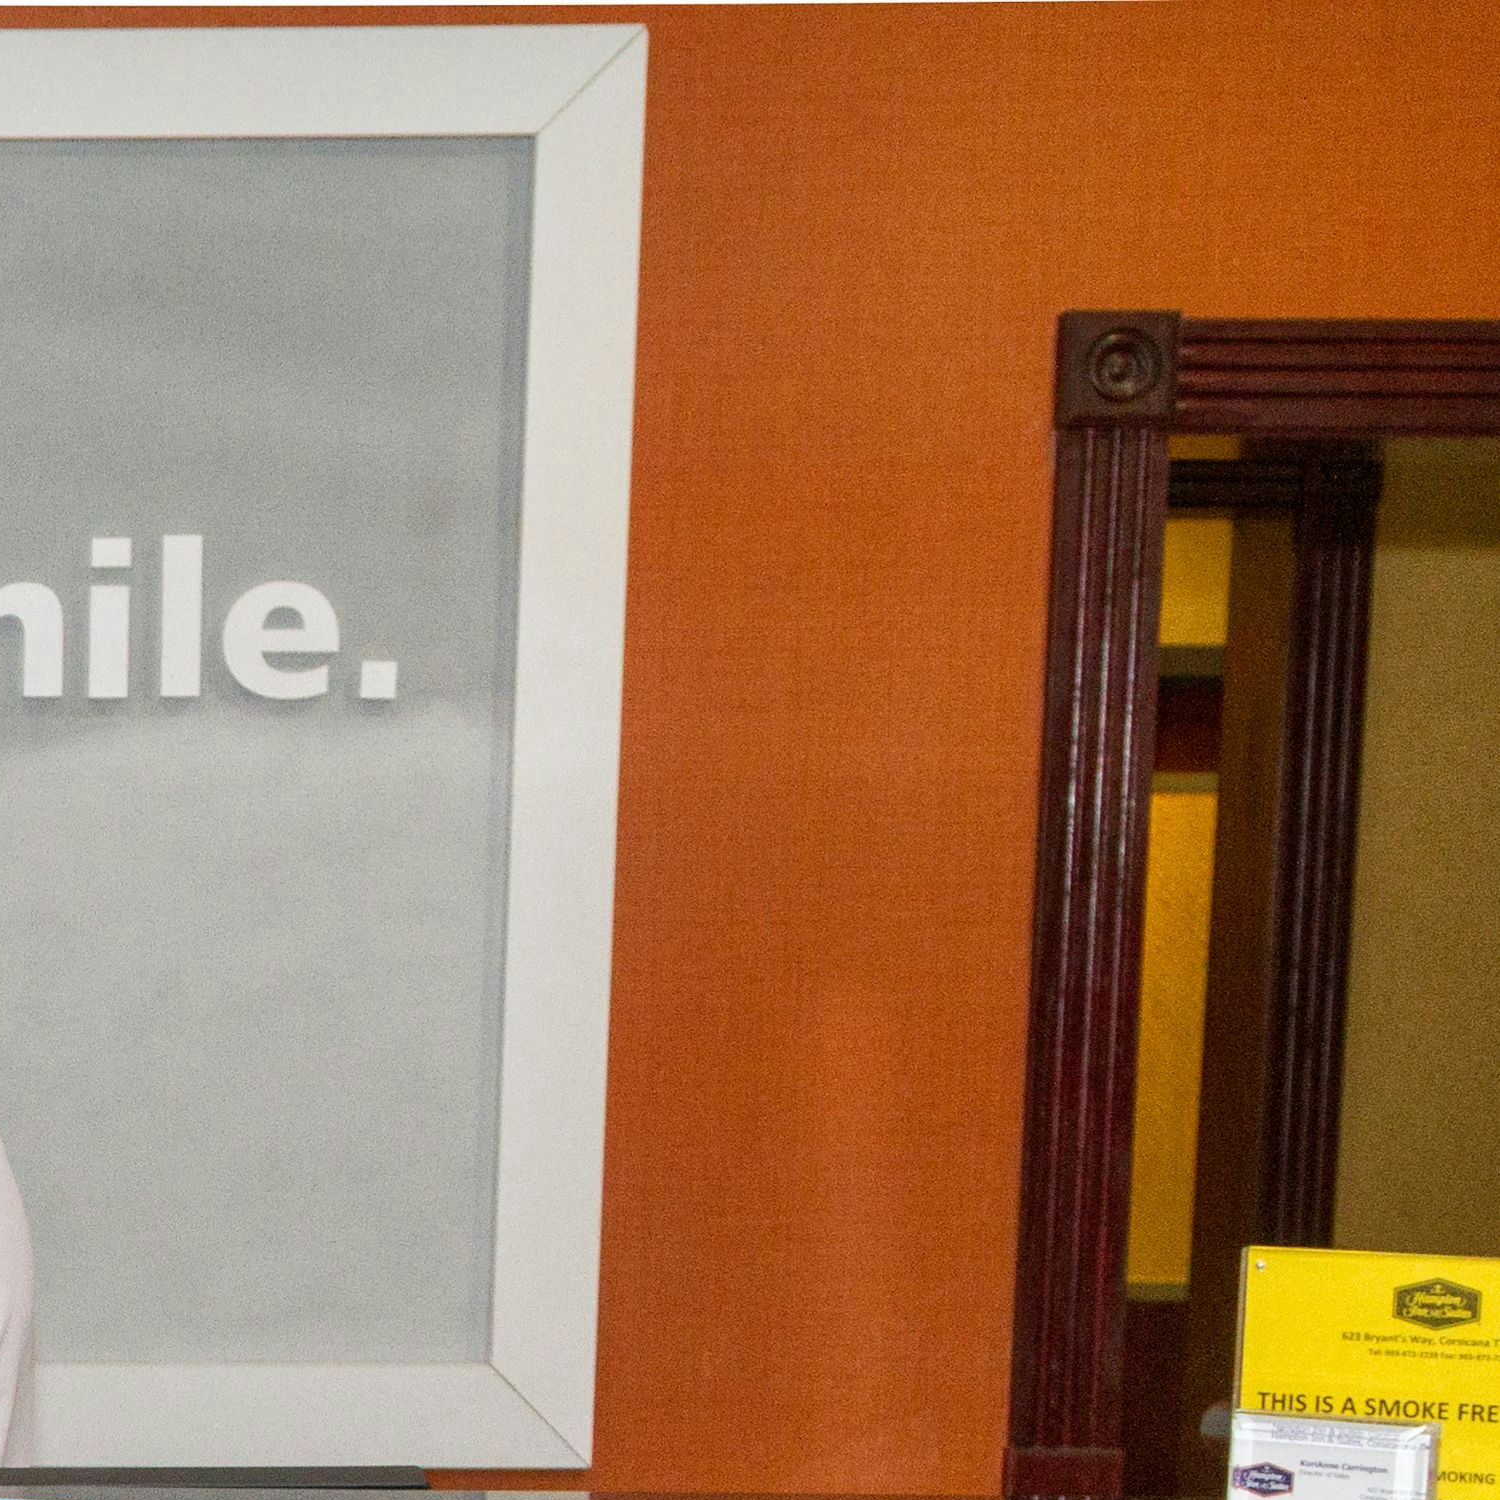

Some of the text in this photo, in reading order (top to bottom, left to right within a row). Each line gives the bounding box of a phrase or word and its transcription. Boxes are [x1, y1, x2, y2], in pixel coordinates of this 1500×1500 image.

[1341, 1331, 1361, 1341] 623
[1439, 1336, 1490, 1347] Corsicana
[1257, 1391, 1308, 1413] THIS
[1315, 1395, 1334, 1413] IS
[1341, 1397, 1356, 1415] A
[1364, 1398, 1450, 1421] SMOKE
[1434, 1470, 1496, 1485] MOKING
